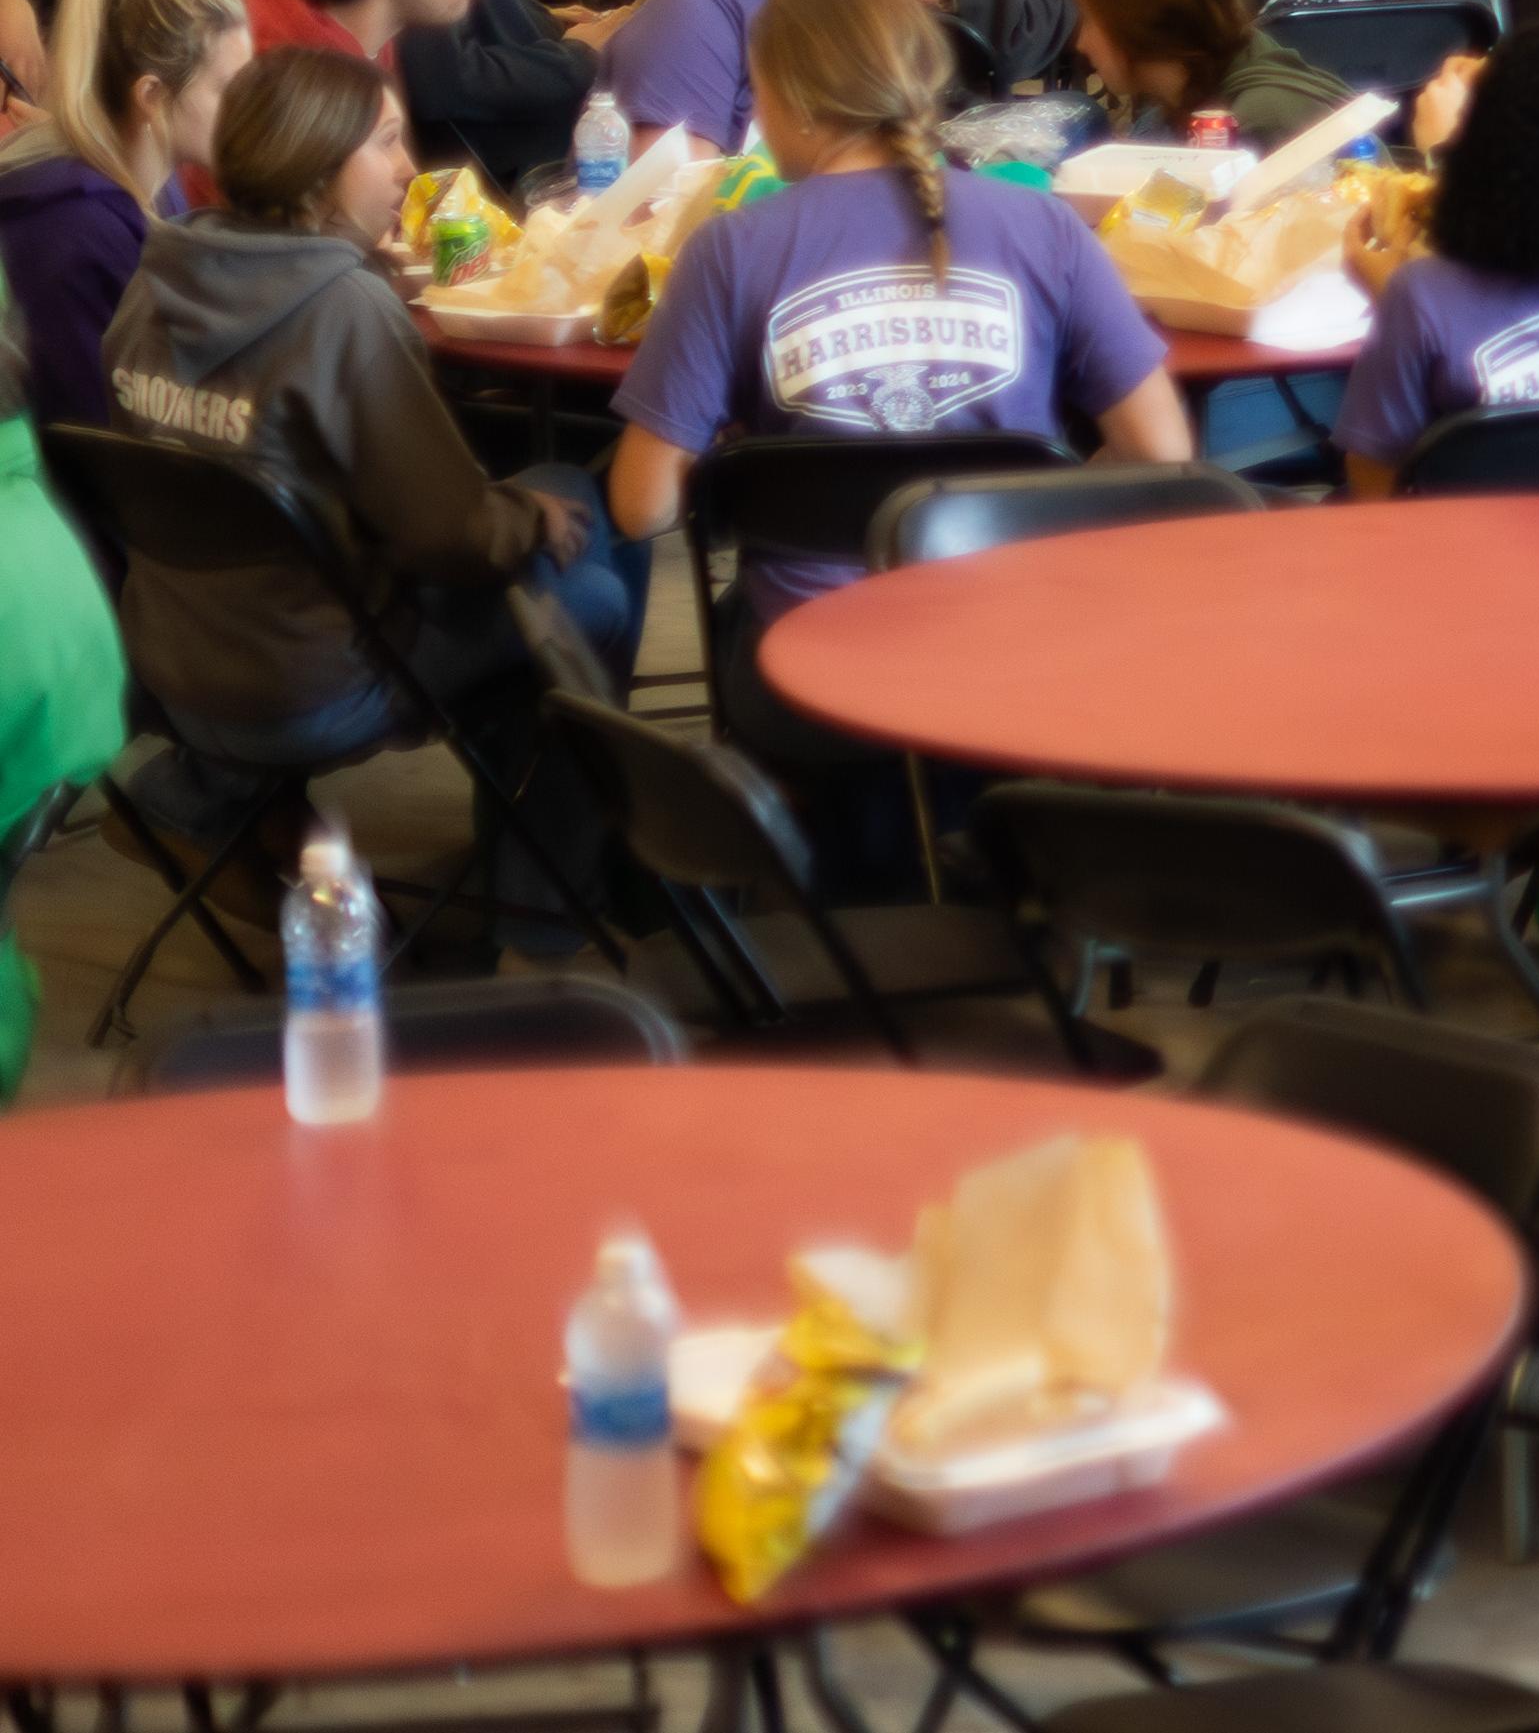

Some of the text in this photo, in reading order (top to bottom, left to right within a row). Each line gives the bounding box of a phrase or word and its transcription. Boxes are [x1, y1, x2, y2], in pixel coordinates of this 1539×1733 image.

[836, 283, 937, 309] ILLINOIS
[780, 315, 1009, 380] HARRISBURG
[826, 371, 971, 400] 2023 2024
